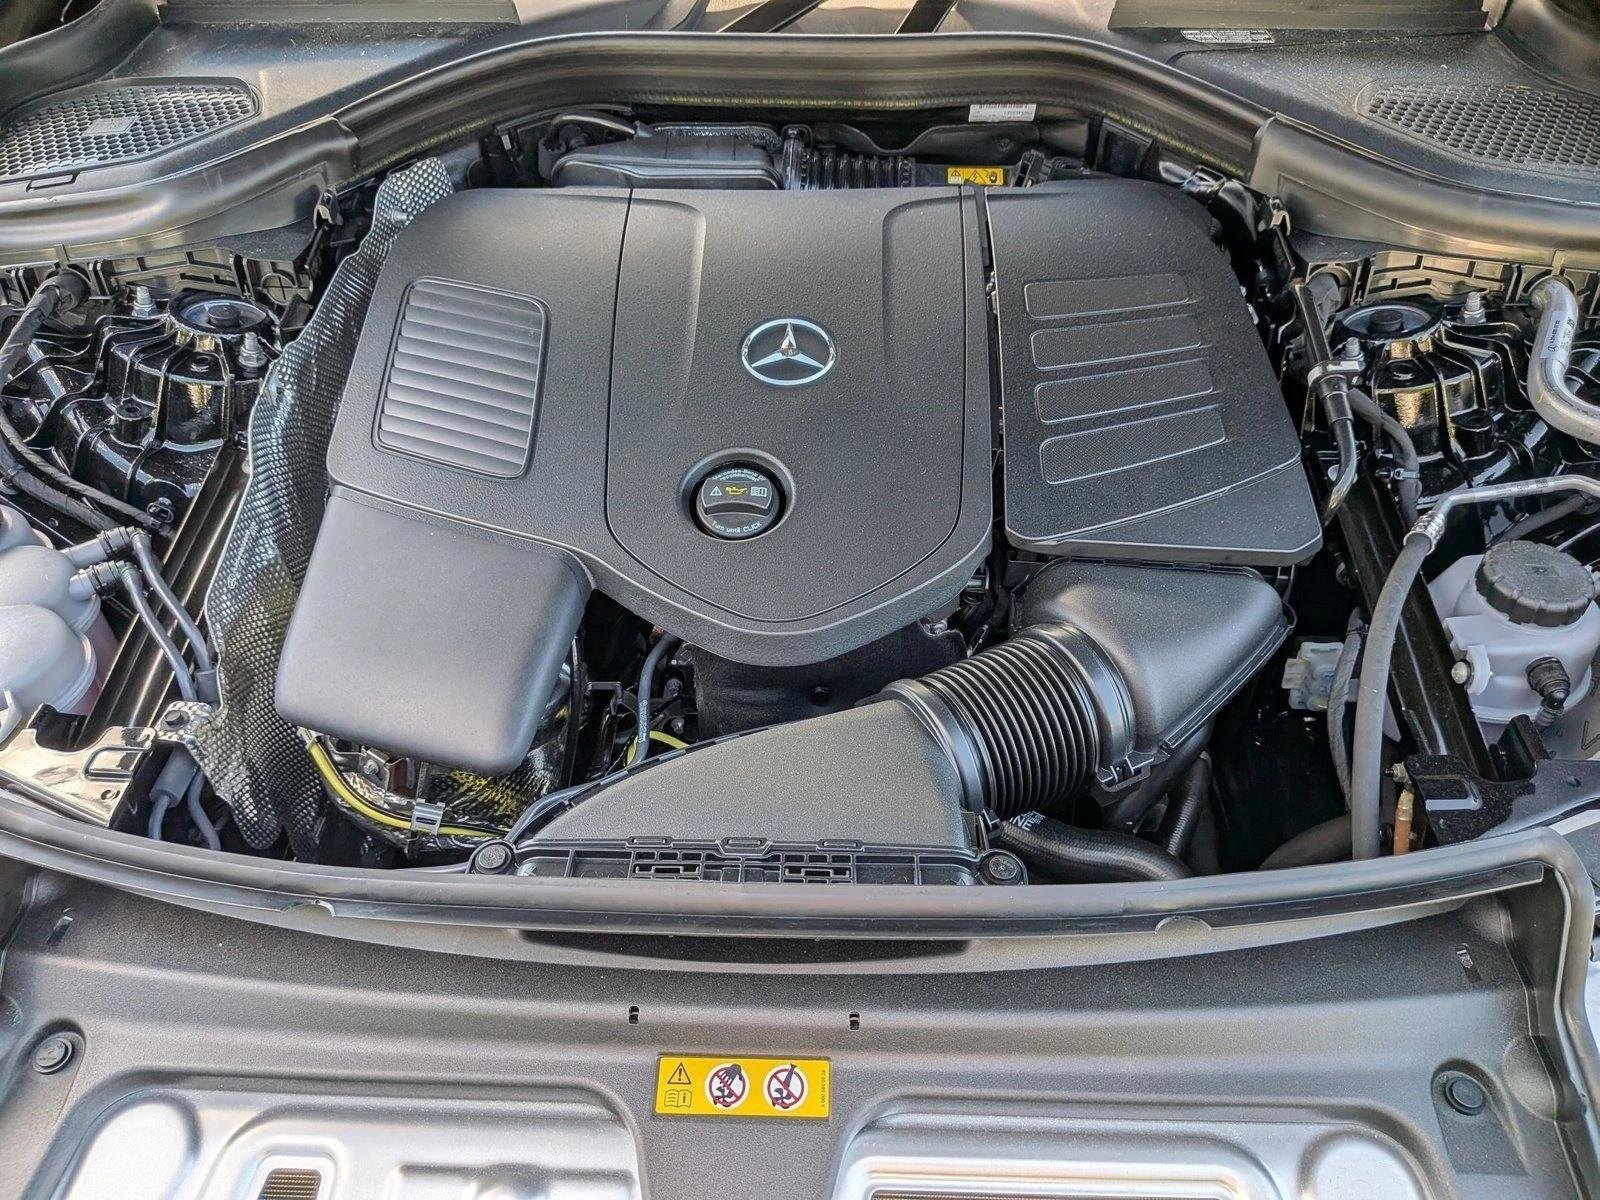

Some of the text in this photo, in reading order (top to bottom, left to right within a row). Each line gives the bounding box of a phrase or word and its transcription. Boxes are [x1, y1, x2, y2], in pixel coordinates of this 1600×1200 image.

[712, 468, 759, 480] Mercedes-Benz
[711, 520, 725, 531] Turn
[743, 521, 763, 532] CLICK
